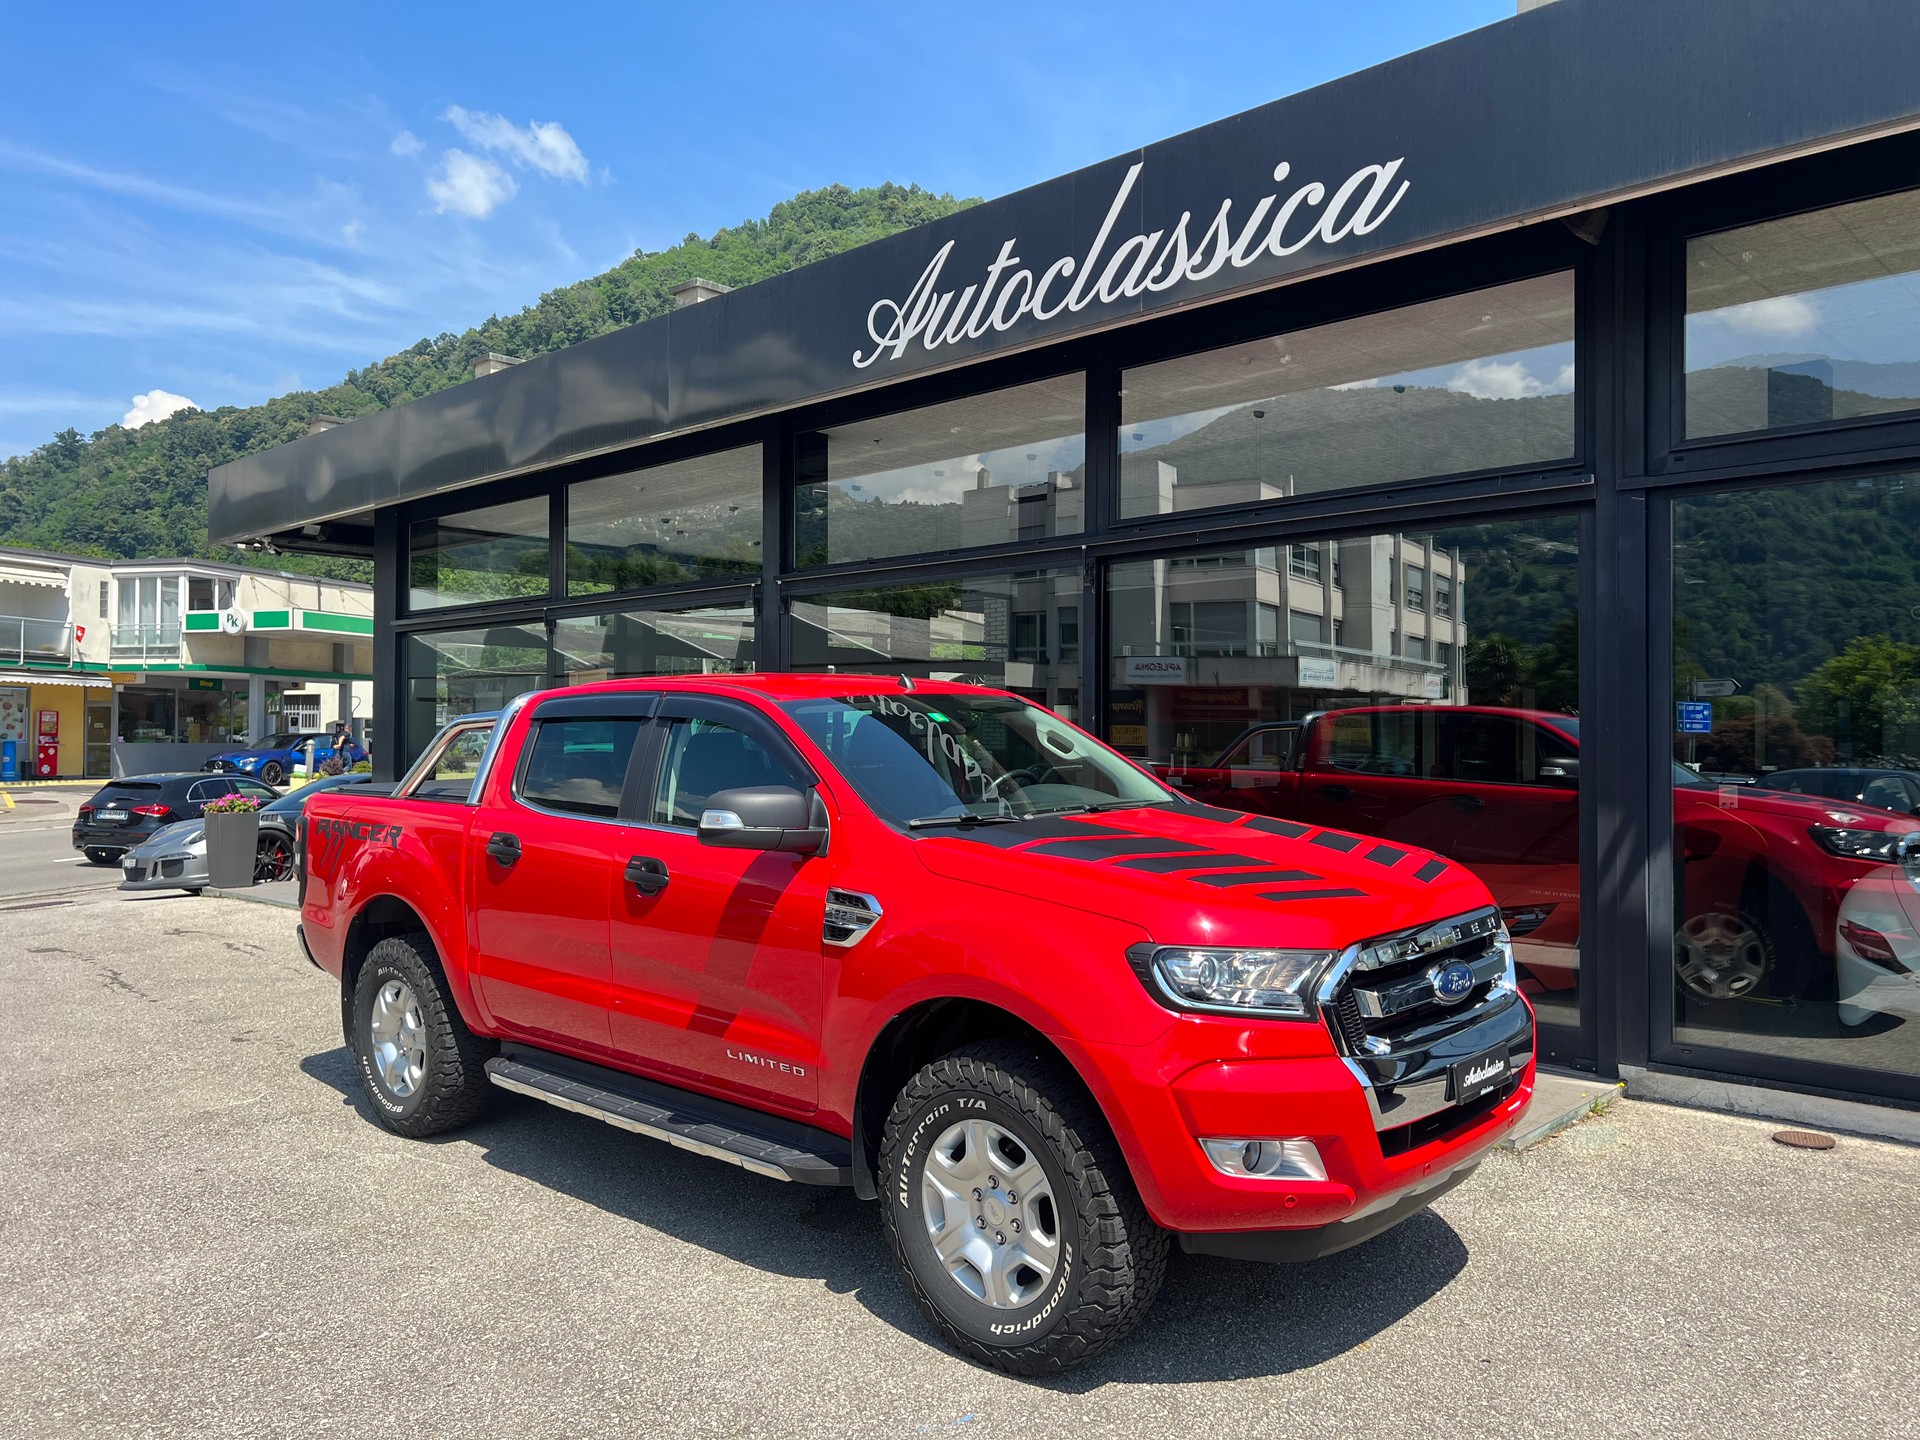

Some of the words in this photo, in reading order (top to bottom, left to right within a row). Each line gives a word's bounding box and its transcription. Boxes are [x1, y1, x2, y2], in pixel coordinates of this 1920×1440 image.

[851, 158, 1411, 369] Autoclassica
[226, 613, 239, 627] PK
[316, 818, 403, 848] RANGER
[1448, 971, 1470, 992] Ford
[726, 1049, 805, 1077] LIMITED
[898, 1103, 950, 1209] All-Terrain
[957, 1098, 987, 1111] T/A
[989, 1241, 1073, 1336] BFGoodrich
